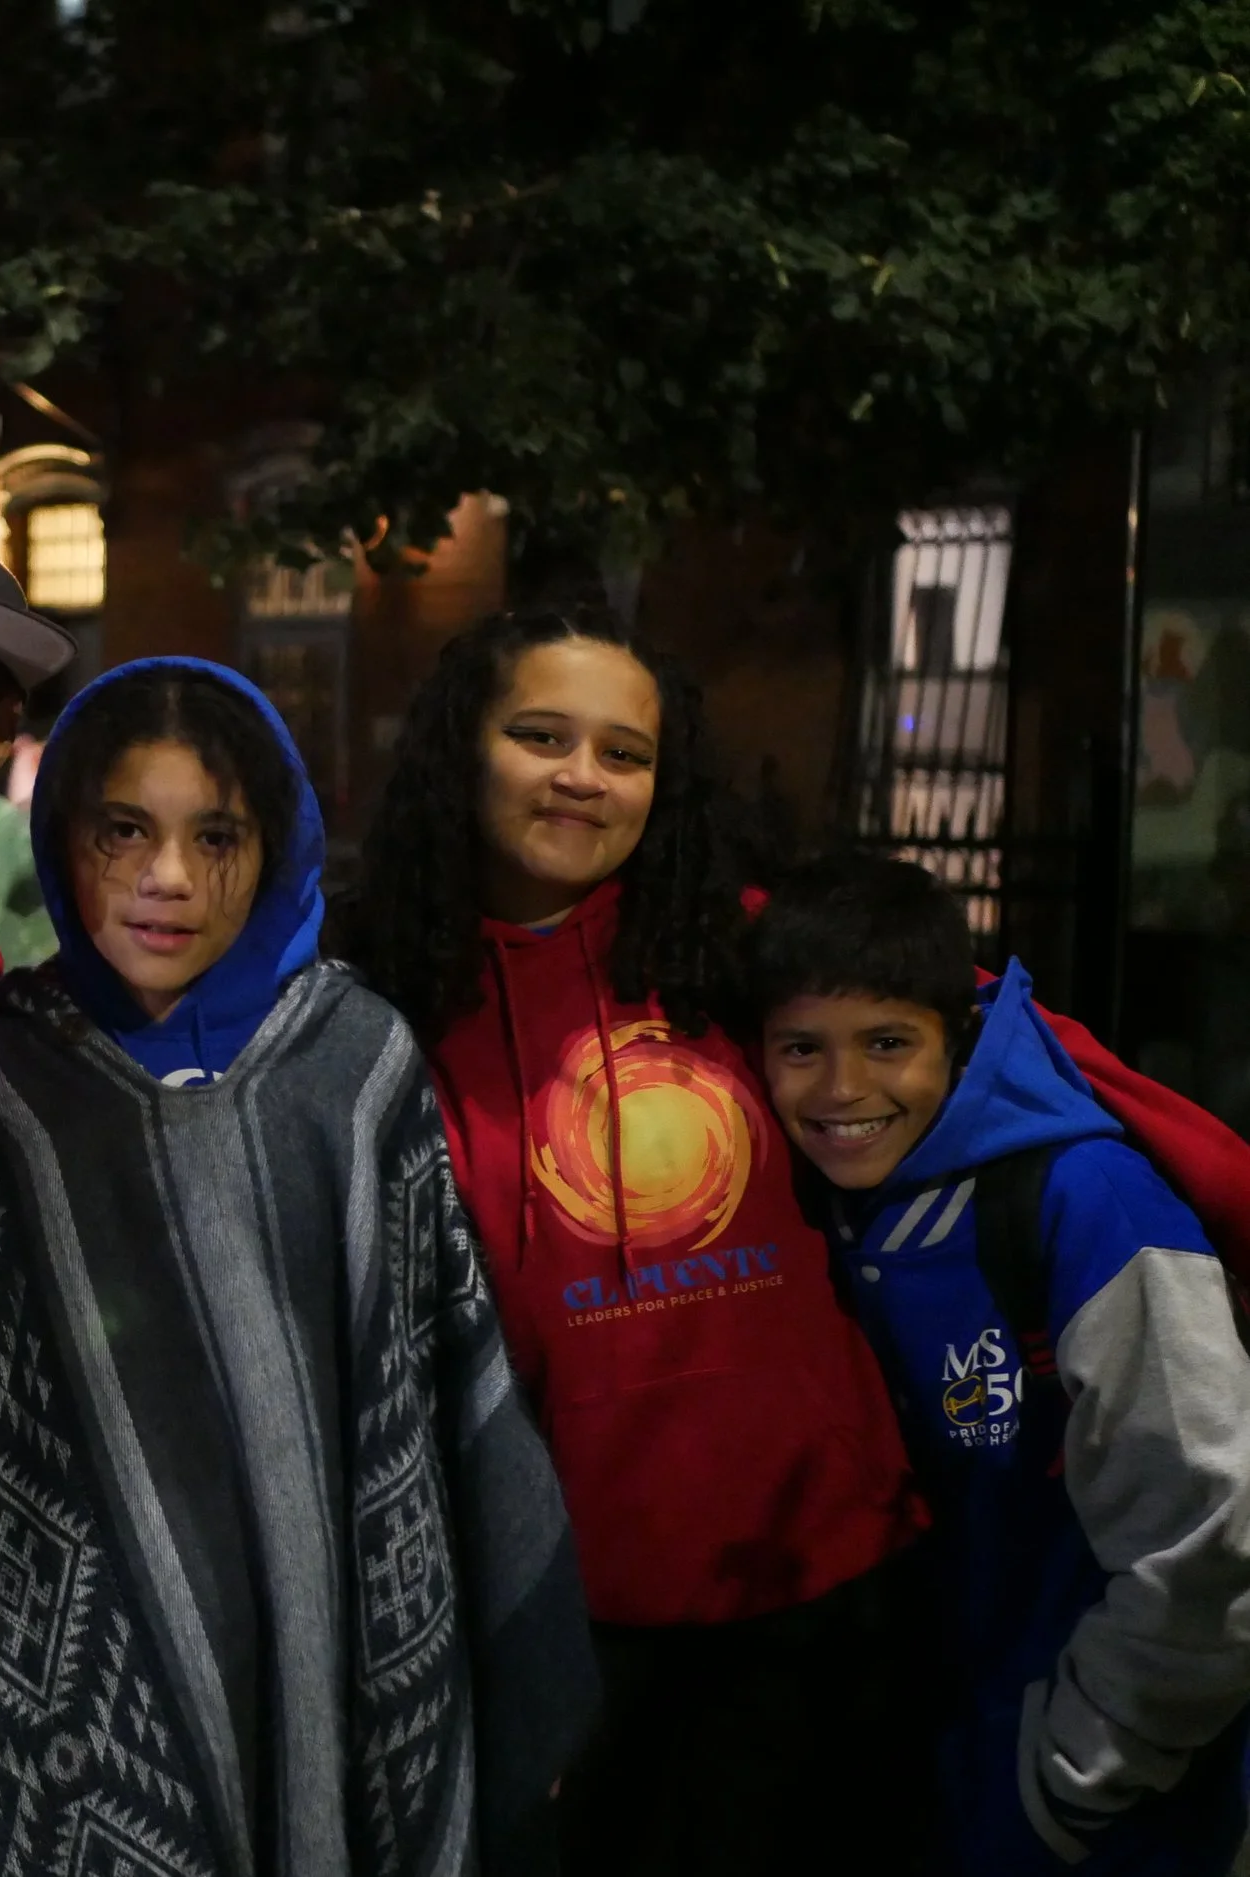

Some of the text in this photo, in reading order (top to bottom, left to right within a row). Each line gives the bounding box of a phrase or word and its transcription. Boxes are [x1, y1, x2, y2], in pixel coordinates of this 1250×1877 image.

[567, 1274, 784, 1327] LEADERS FOR PEACE & JUSTICE
[942, 1328, 1007, 1381] MS
[948, 1421, 1011, 1439] PRID OF
